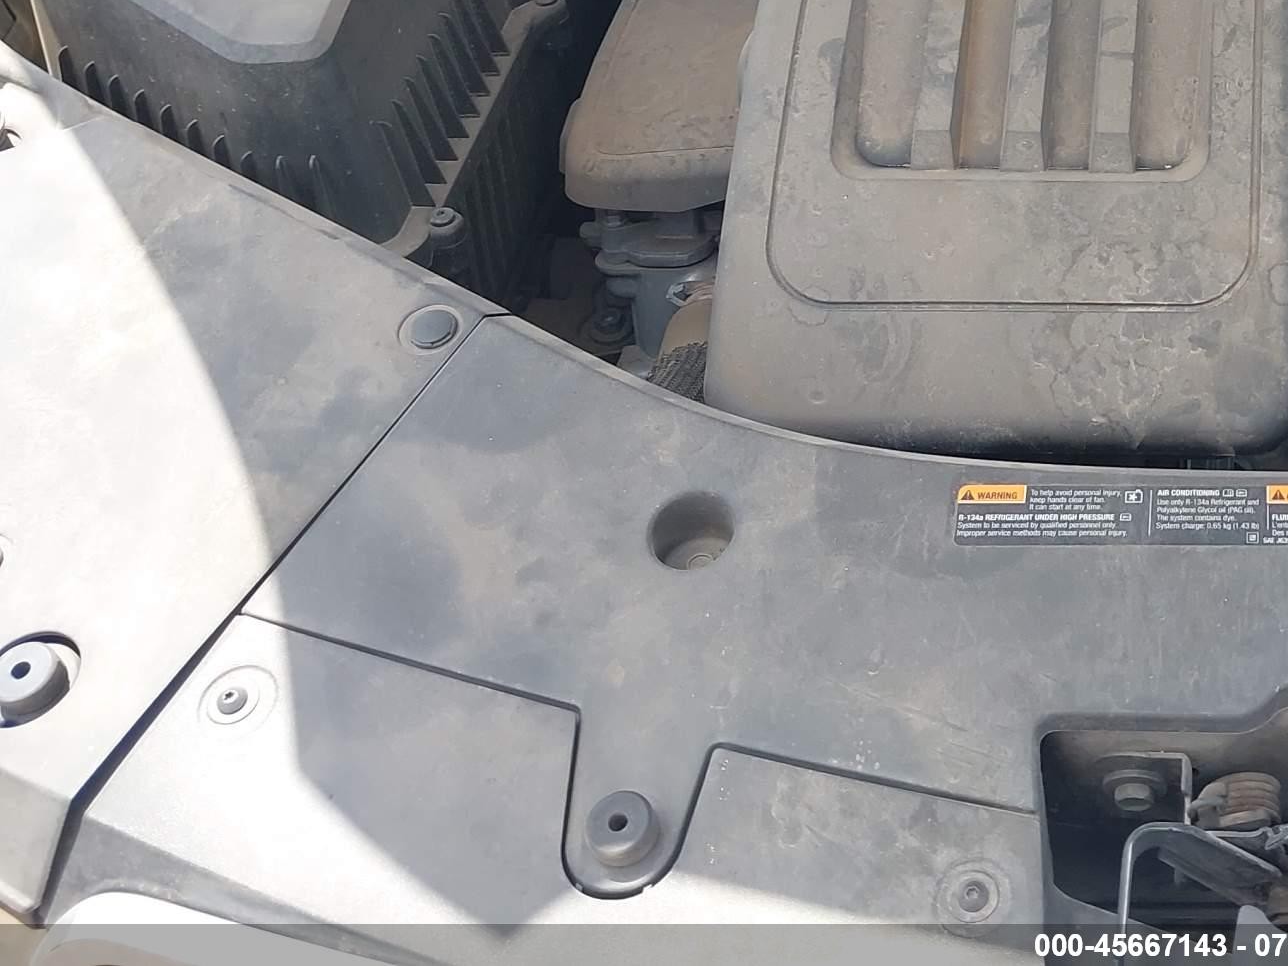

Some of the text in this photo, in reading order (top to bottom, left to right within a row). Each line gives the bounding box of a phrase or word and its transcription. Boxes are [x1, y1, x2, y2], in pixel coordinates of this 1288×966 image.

[978, 491, 1018, 500] WARNING
[1040, 489, 1054, 497] help
[1074, 489, 1102, 497] personal
[958, 522, 982, 530] System
[1030, 522, 1039, 530] by
[1040, 522, 1068, 530] qualified
[1068, 522, 1101, 530] personnel
[1156, 522, 1180, 530] System
